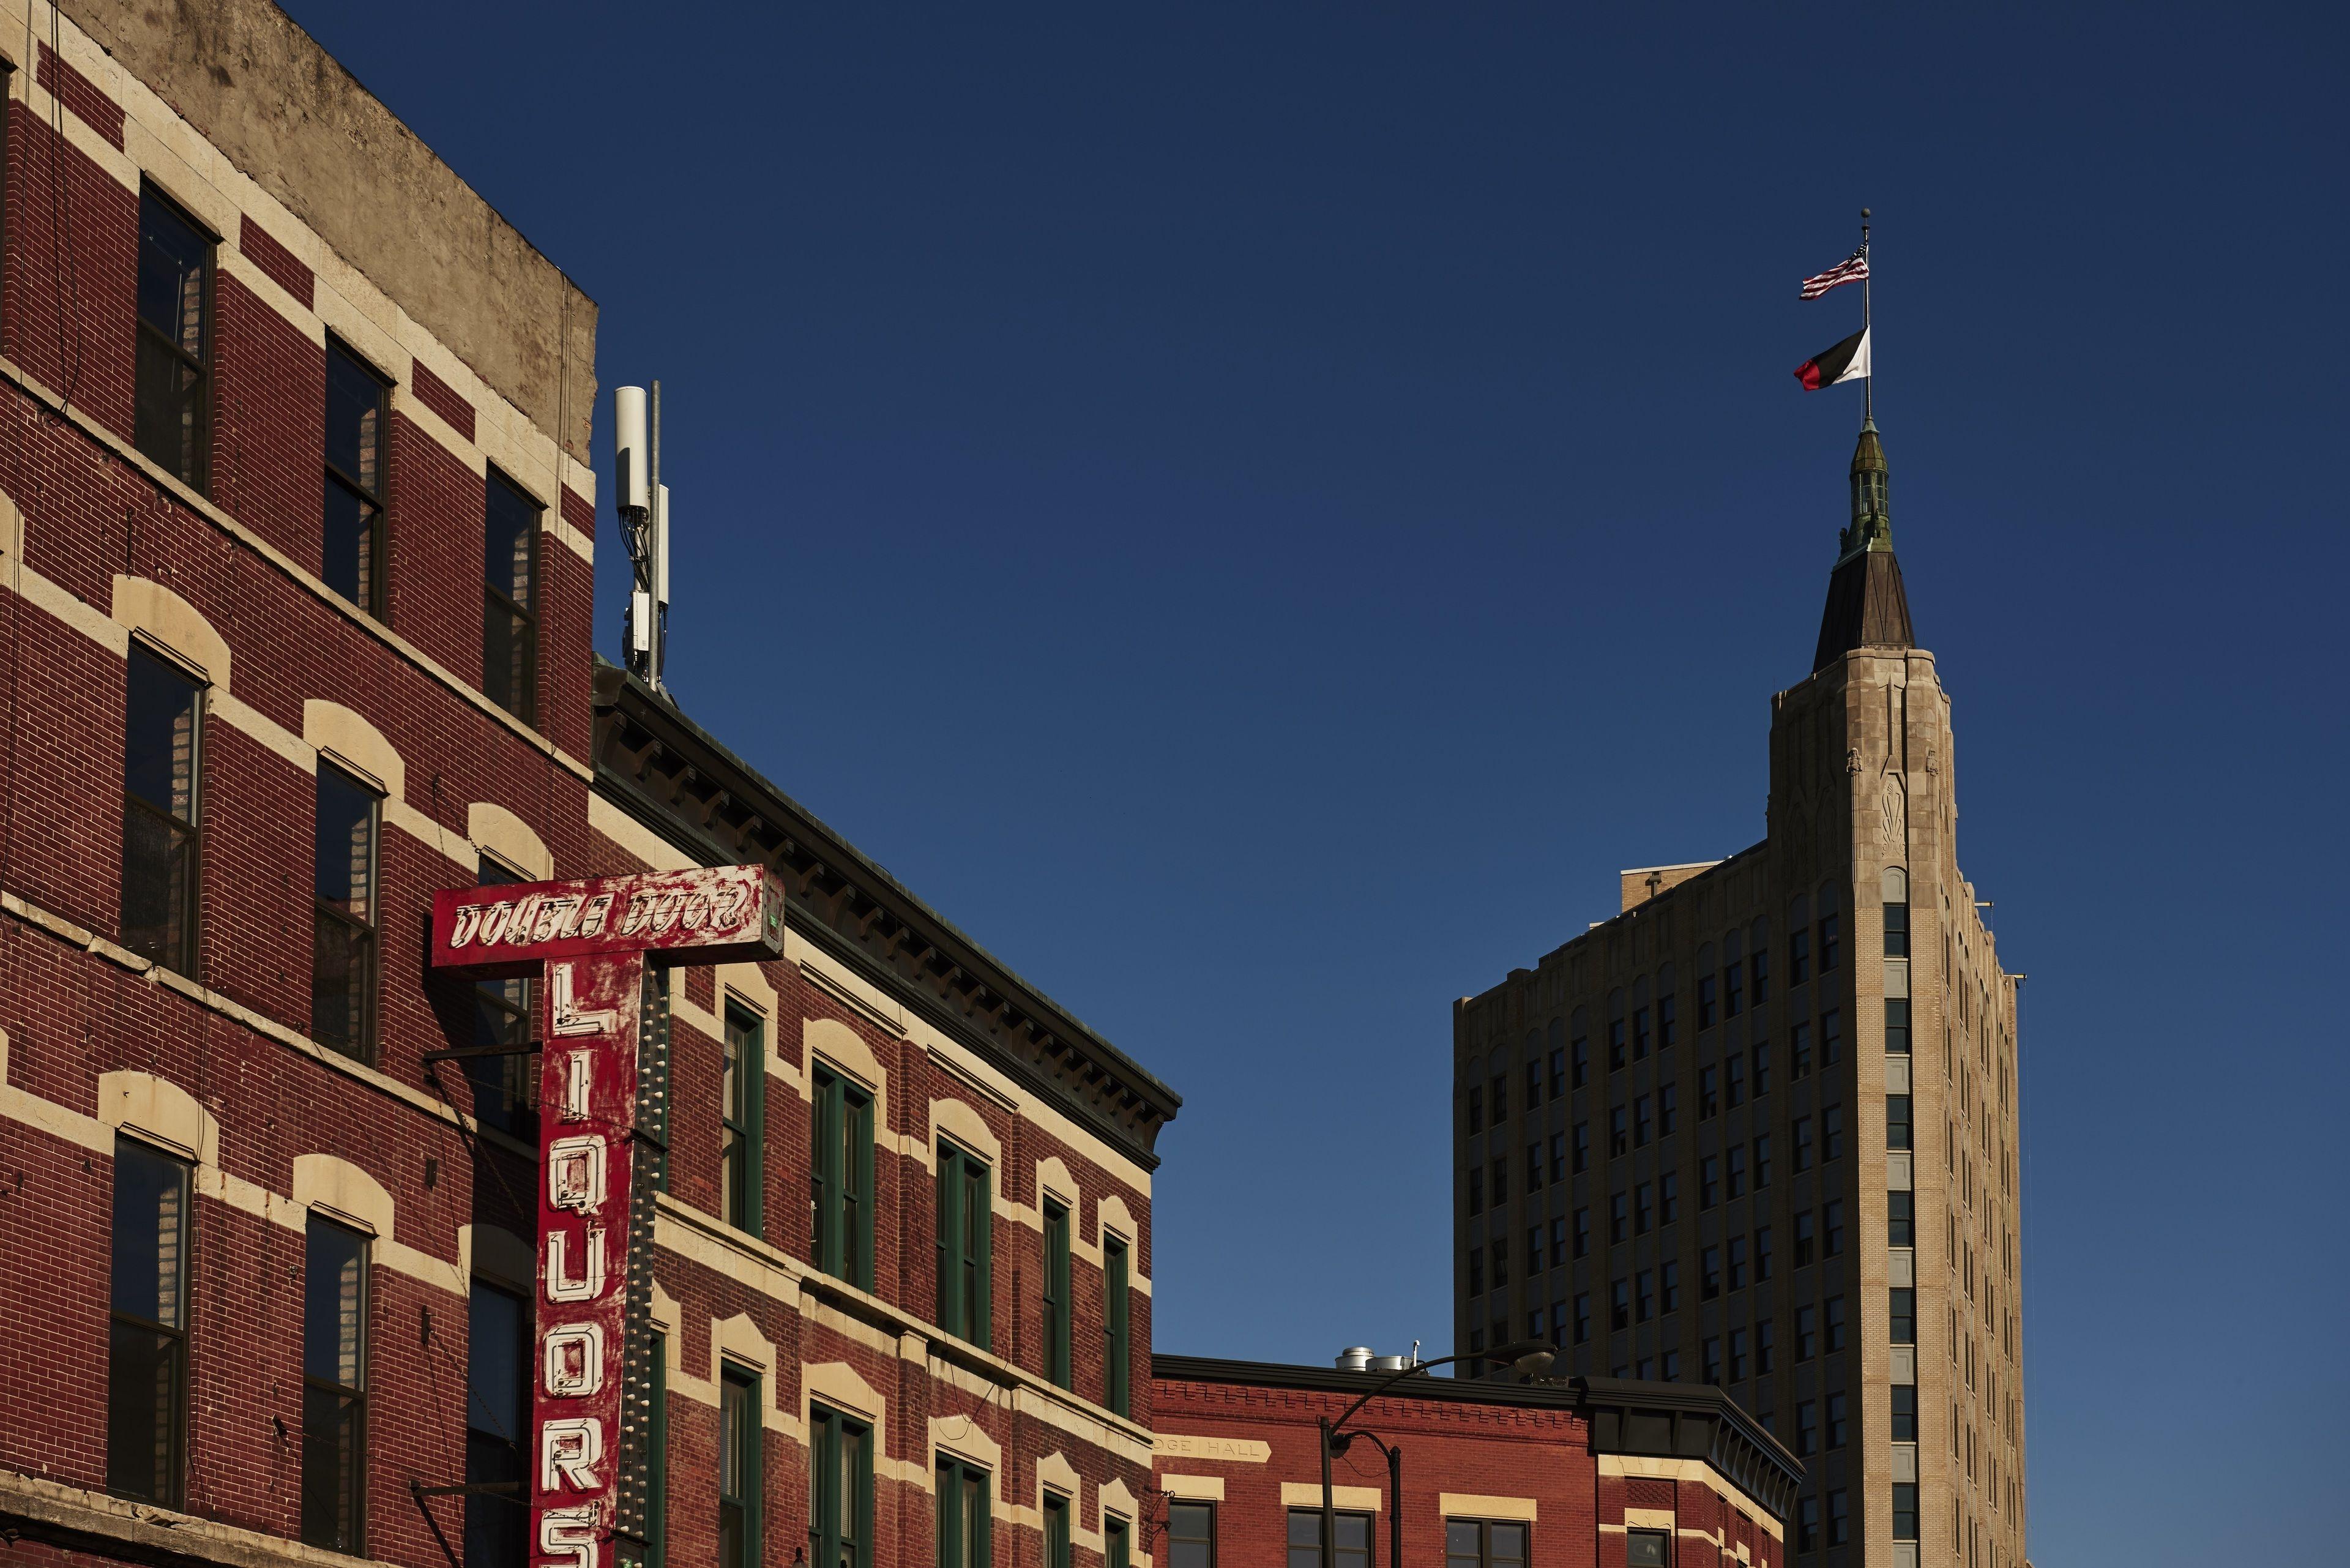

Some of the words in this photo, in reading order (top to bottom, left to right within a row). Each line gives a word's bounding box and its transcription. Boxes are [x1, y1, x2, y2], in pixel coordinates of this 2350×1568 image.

[449, 892, 614, 948] DOUBLE
[621, 884, 748, 936] DOOR
[540, 963, 617, 1568] LIQUORS
[1207, 1442, 1259, 1456] HALL
